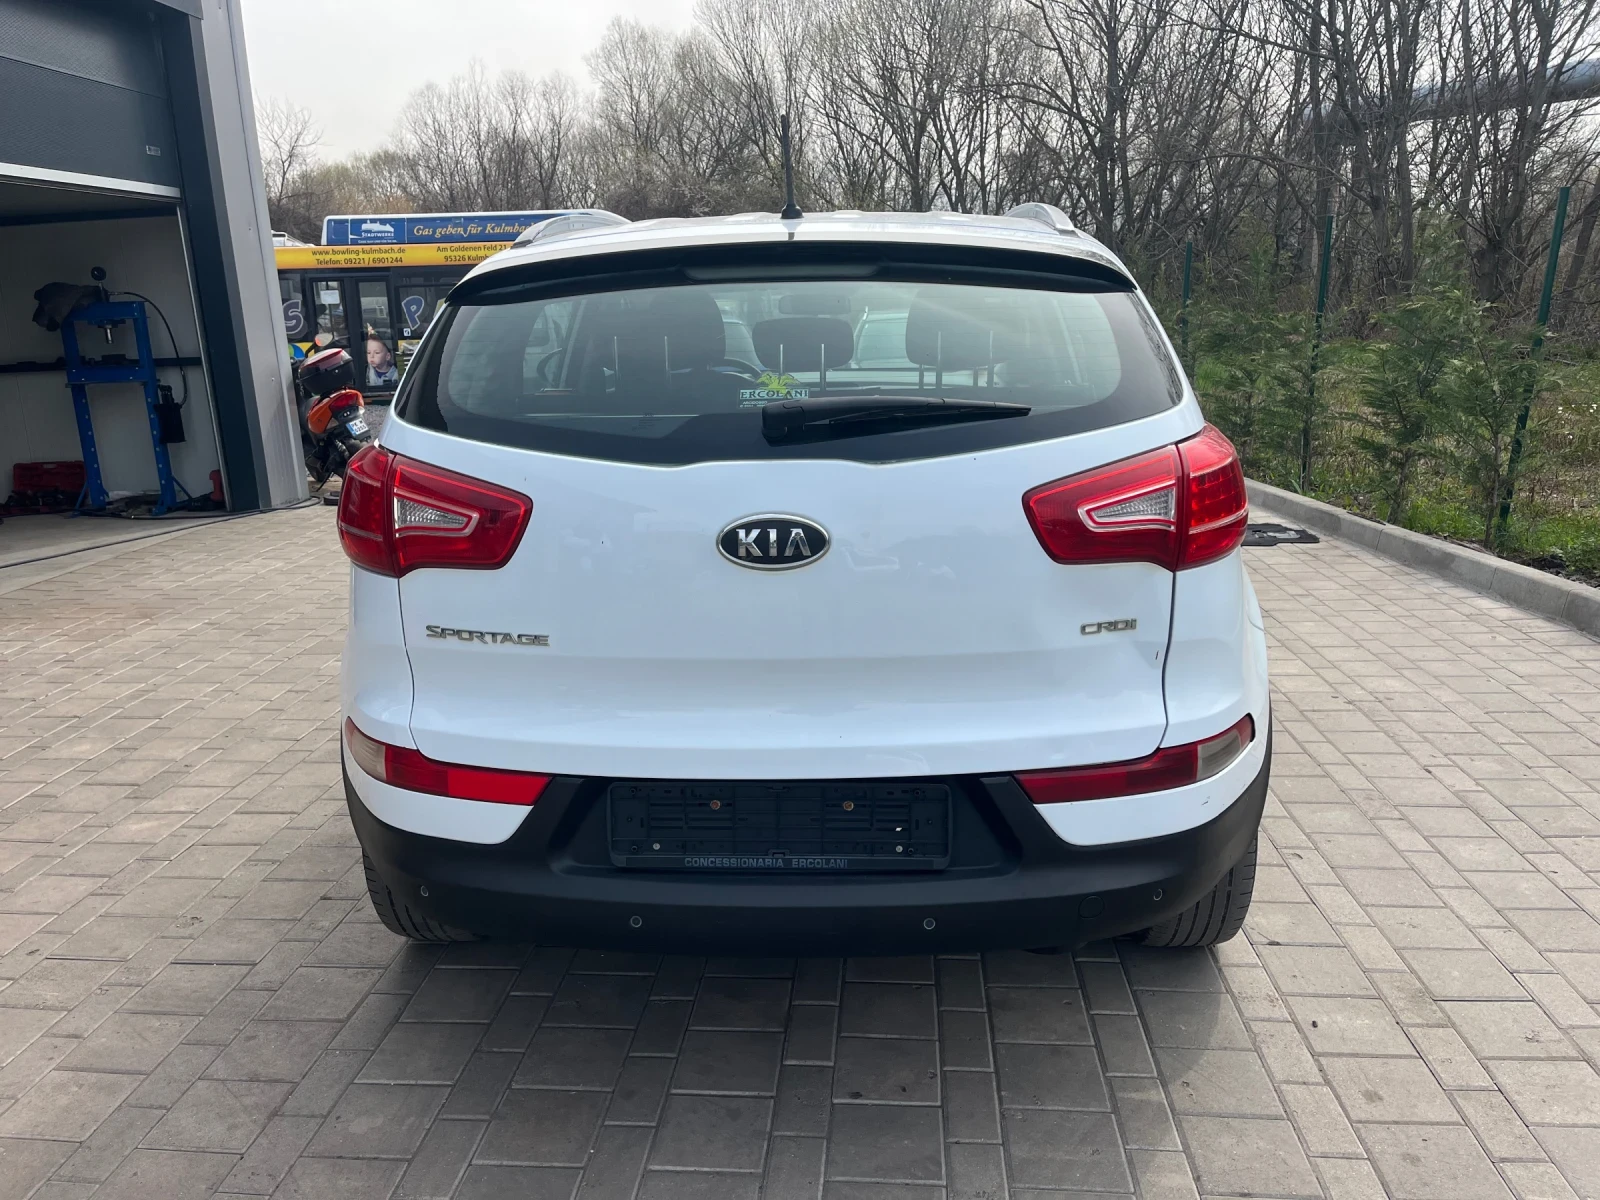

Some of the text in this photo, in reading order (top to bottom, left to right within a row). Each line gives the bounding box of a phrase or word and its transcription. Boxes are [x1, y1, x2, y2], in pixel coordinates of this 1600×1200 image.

[414, 222, 536, 238] Gas geben für Kulmba
[311, 247, 406, 257] www.bowling-kulmbach.de
[449, 245, 483, 253] Goldenen
[484, 244, 498, 252] Feld
[315, 258, 343, 266] Telefon:
[343, 257, 366, 265] 09221
[372, 256, 403, 265] 6901244
[443, 255, 466, 263] 95326
[740, 390, 808, 399] ERCOLANI
[736, 528, 812, 557] KIA
[425, 624, 550, 647] SPORTAGE
[684, 857, 848, 869] CONCESSIONARIA ERCOLANI
